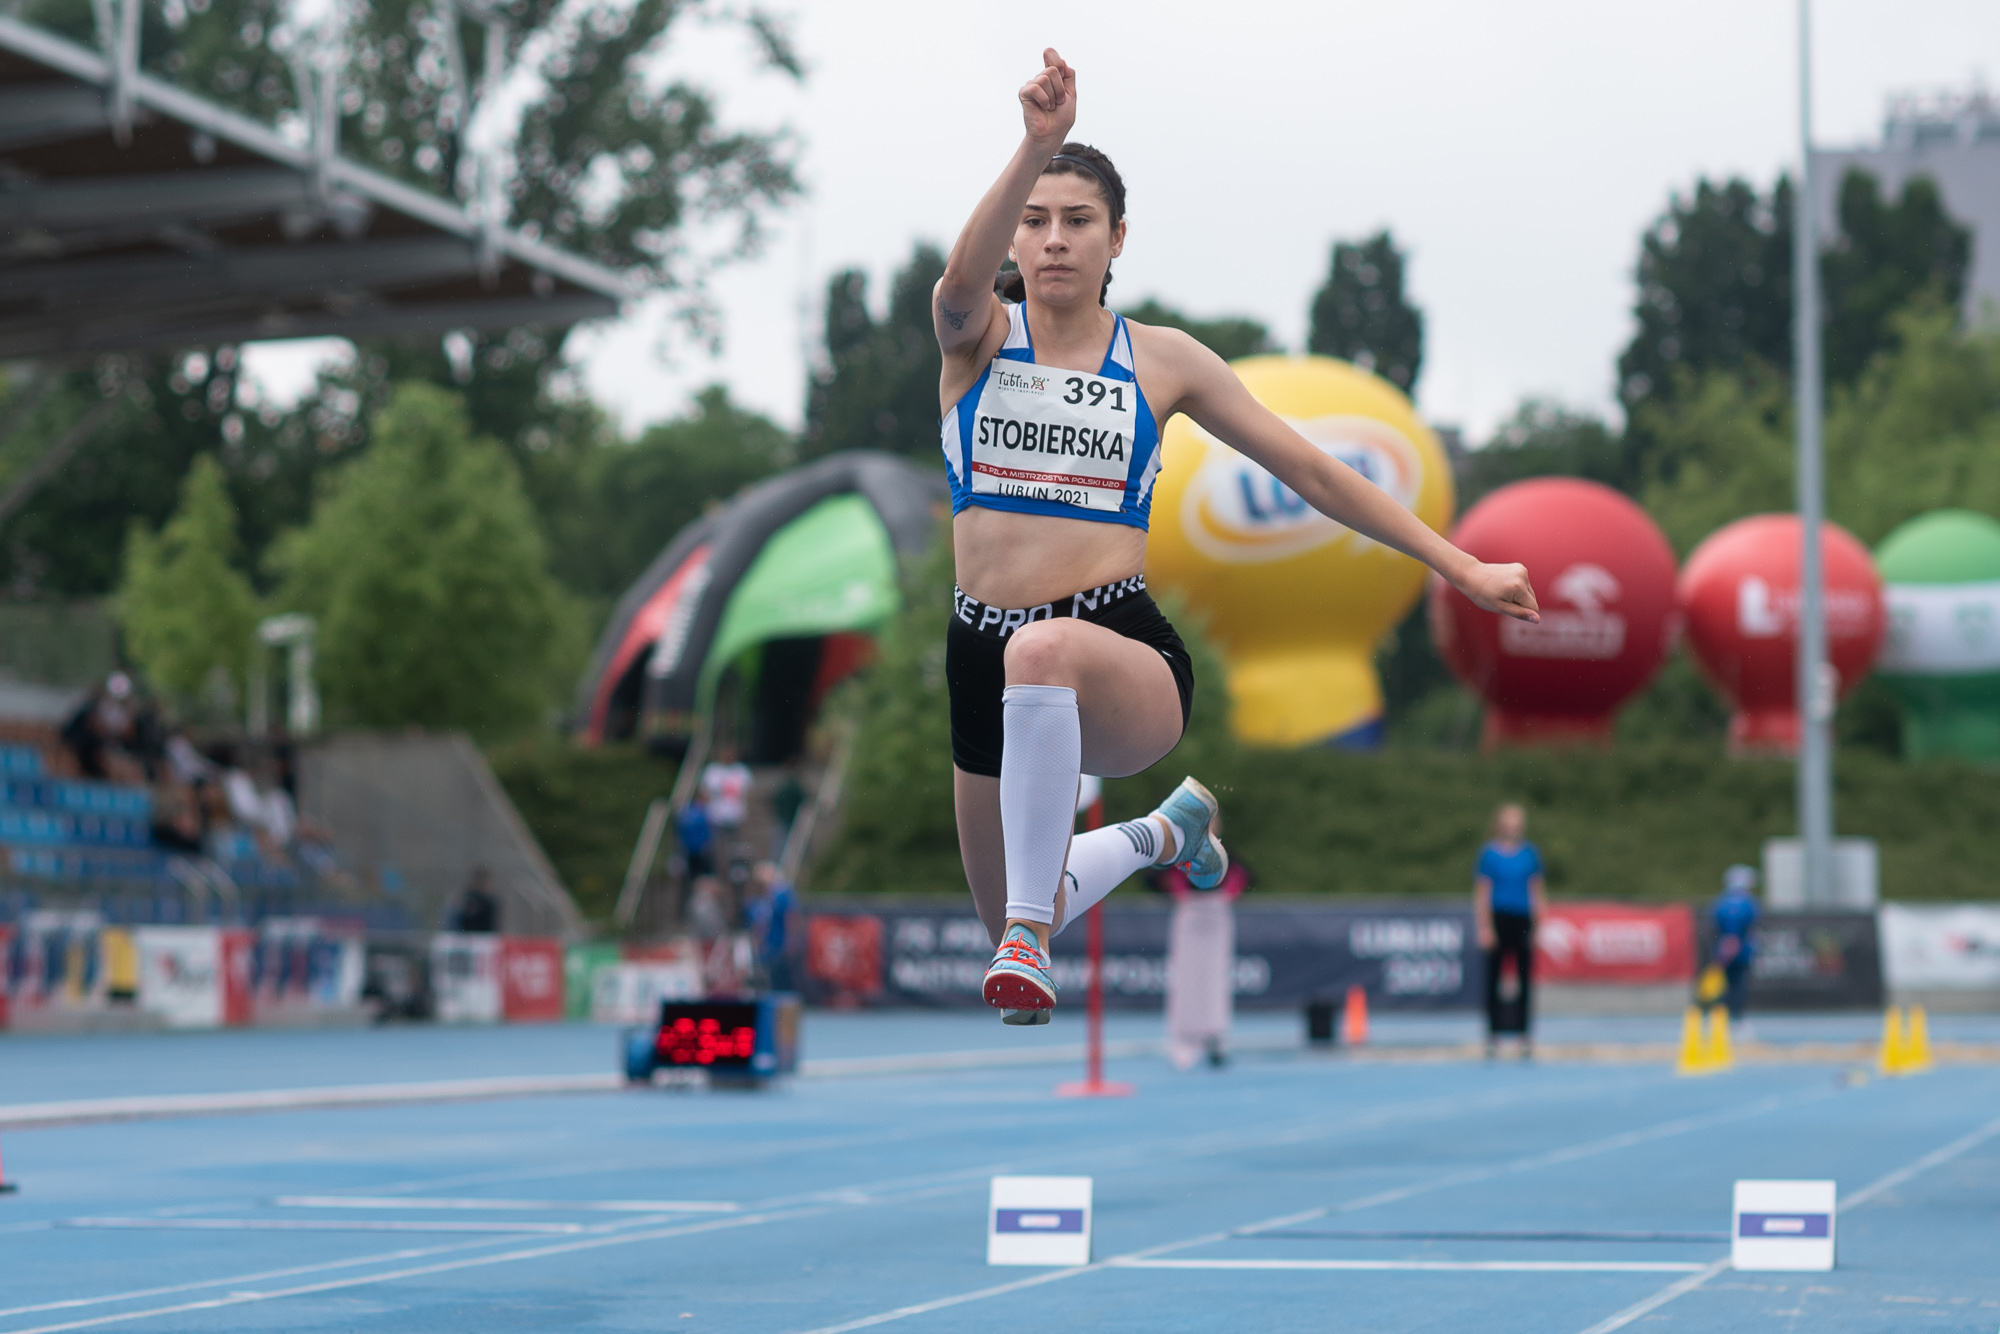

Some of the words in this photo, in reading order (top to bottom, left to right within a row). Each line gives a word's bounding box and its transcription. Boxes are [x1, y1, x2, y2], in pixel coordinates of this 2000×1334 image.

[1063, 377, 1127, 412] 391
[978, 416, 1124, 461] STOBIERSKA
[1009, 471, 1070, 483] MISTRZOSTWA
[1071, 477, 1102, 486] POLSKI
[998, 483, 1049, 500] LUBLIN
[1054, 488, 1089, 505] 2021
